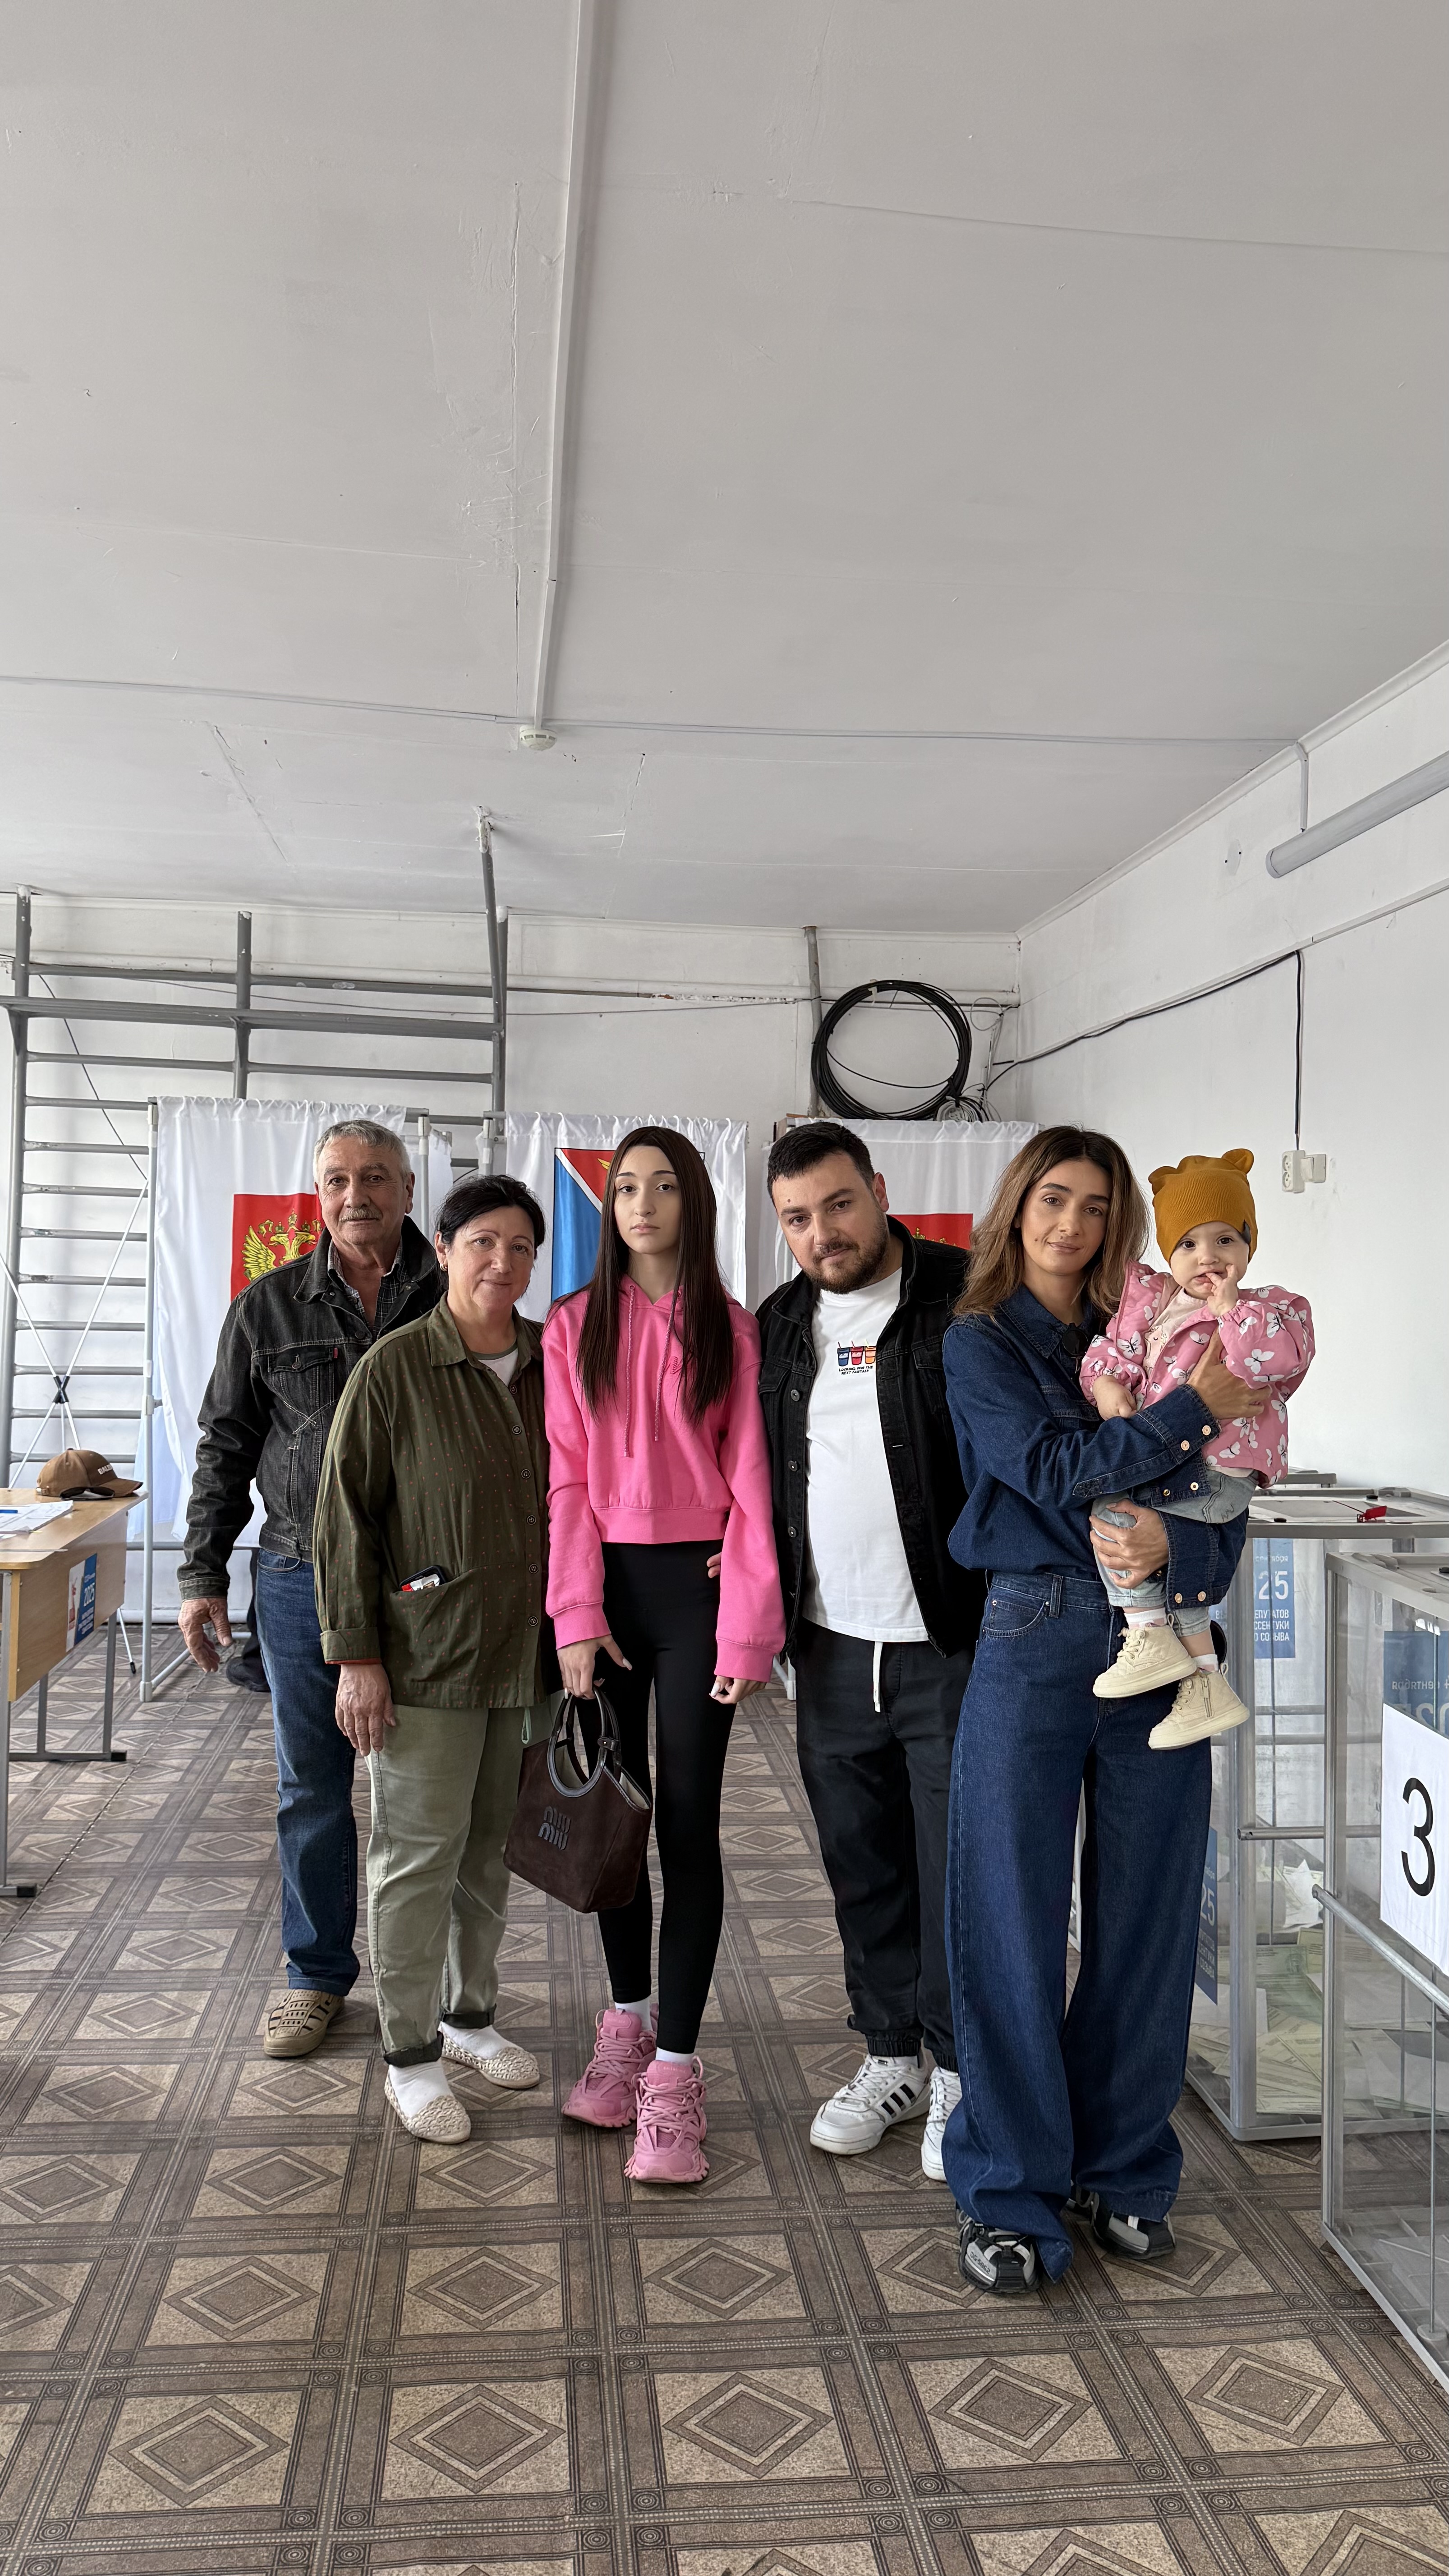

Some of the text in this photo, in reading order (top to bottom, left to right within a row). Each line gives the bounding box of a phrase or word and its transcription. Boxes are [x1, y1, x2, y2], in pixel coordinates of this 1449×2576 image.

[1256, 1554, 1288, 1563] сенября
[1256, 1570, 1288, 1600] 25
[1255, 1609, 1289, 1619] ЕПУАТОВ
[1260, 1632, 1289, 1641] СОЫВА
[1401, 1777, 1435, 1896] 3
[1201, 1882, 1214, 1926] 25
